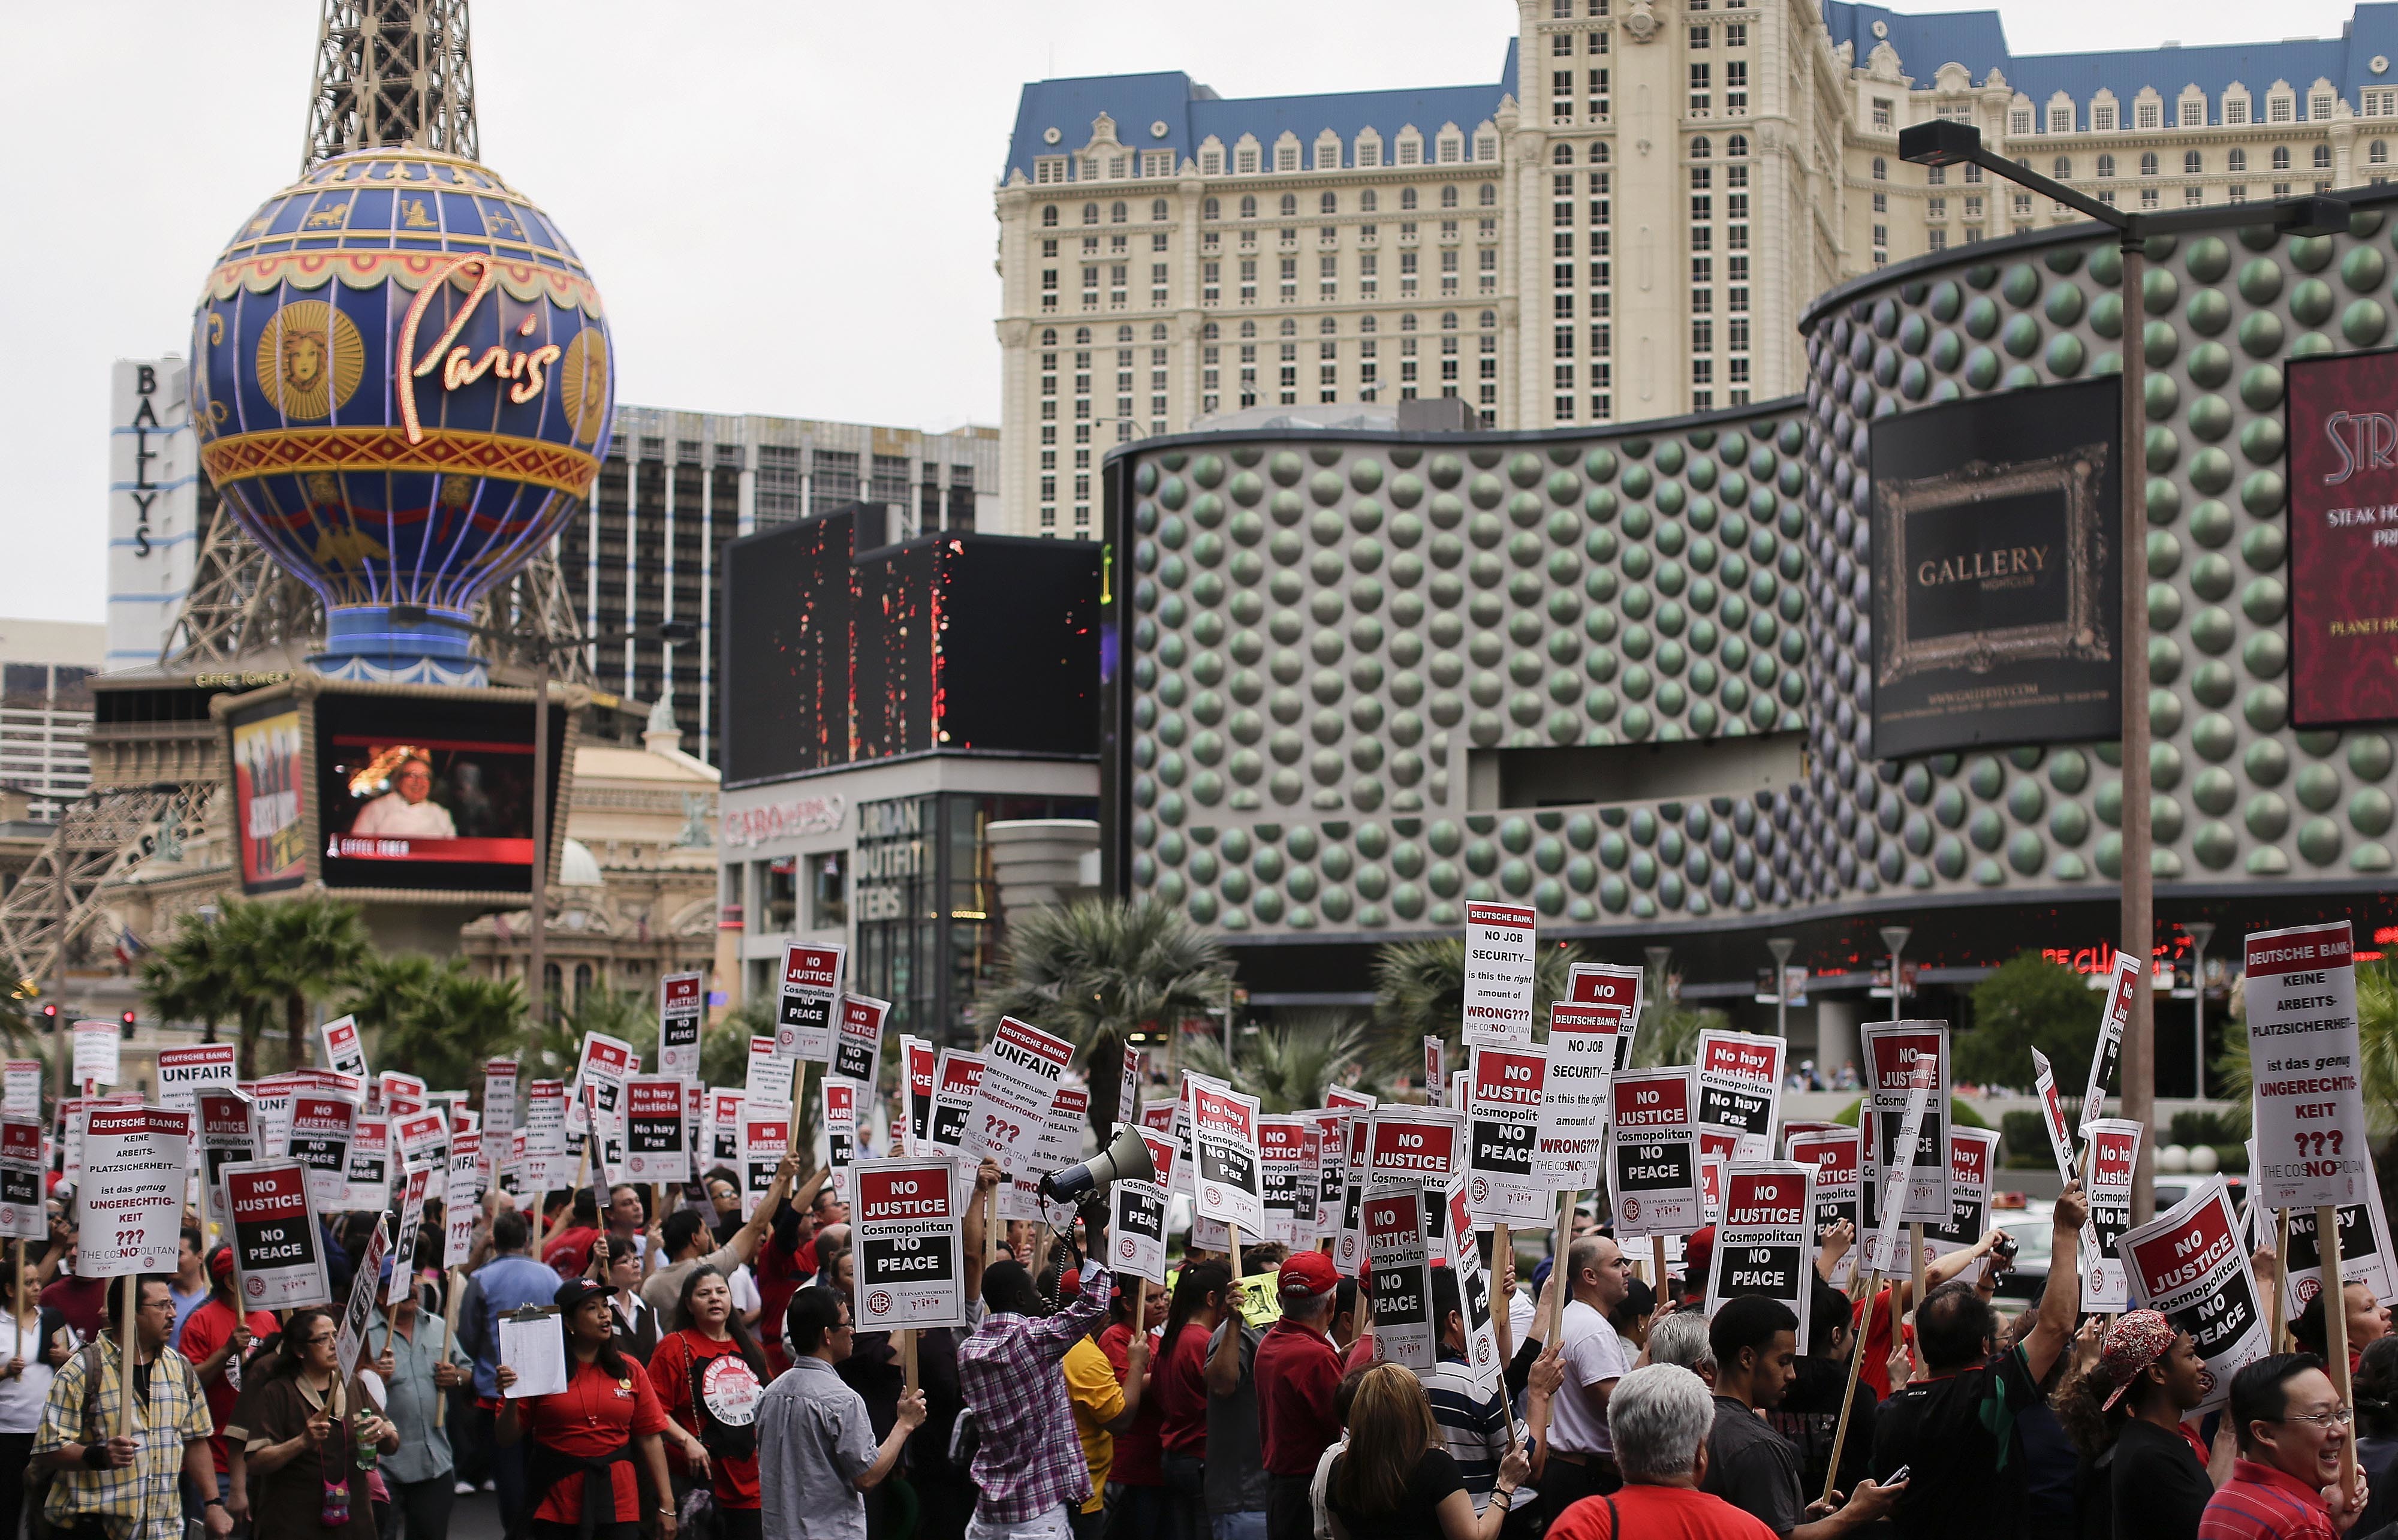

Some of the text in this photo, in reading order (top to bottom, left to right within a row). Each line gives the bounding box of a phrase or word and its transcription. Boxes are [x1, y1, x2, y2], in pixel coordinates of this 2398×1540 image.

[395, 251, 562, 444] Paris
[131, 364, 159, 557] BALLYS
[1918, 546, 2049, 586] GALLERY
[1471, 911, 1533, 924] DEUTSCHE BANK:
[1485, 931, 1523, 942] NO JOB
[807, 957, 820, 966] NO
[2249, 944, 2315, 966] DEUTSCHE
[2319, 942, 2350, 958] BANK:
[789, 969, 833, 982] JUSTICE
[1478, 972, 1494, 981] this
[1498, 973, 1511, 982] the
[1514, 974, 1532, 984] right
[2283, 972, 2325, 987] KEINE
[785, 985, 834, 998] Cosmopolitan
[1478, 990, 1521, 999] amount of
[1593, 985, 1615, 997] NO
[2123, 981, 2133, 1000] No
[2276, 994, 2337, 1012] ARBEITS-
[790, 1008, 823, 1020] PEACE
[852, 1010, 867, 1021] NO
[1467, 1006, 1529, 1021] WRONG???
[1555, 1015, 1617, 1026] DEUTSCHE BANK:
[671, 1029, 694, 1040] PEACE
[1465, 1023, 1478, 1031] THE
[1001, 1026, 1067, 1060] DEUTSCHE BANK:
[1568, 1039, 1603, 1052] NO JOB
[846, 1047, 861, 1057] NO
[1715, 1048, 1767, 1066] No hay
[1899, 1048, 1917, 1063] NO
[994, 1041, 1061, 1081] UNFAIR
[2267, 1057, 2309, 1072] ist das
[163, 1066, 231, 1081] UNFAIR
[1505, 1065, 1532, 1081] NO
[1700, 1072, 1773, 1095] Cosmopolitan
[2260, 1075, 2357, 1098] UNGERECHTIG-
[634, 1089, 675, 1099] No hay
[991, 1081, 1037, 1107] ist das genug
[1062, 1096, 1084, 1107] BANK:
[1546, 1093, 1607, 1106] is this the right
[1637, 1091, 1659, 1104] NO
[631, 1102, 678, 1113] Justicia
[979, 1089, 1043, 1122] UNGERECHTIGKEIT
[1710, 1092, 1762, 1113] No hay
[313, 1105, 332, 1116] NO
[1201, 1099, 1245, 1125] No hay
[1618, 1108, 1684, 1125] JUSTICE
[2295, 1102, 2336, 1119] KEIT
[92, 1117, 183, 1128] DEUTSCHE BANK:
[1556, 1116, 1596, 1127] amount of
[1720, 1111, 1748, 1126] Paz
[635, 1124, 675, 1134] No hay
[986, 1114, 1020, 1143] ???
[1049, 1122, 1079, 1133] HEALTH-
[1200, 1117, 1248, 1141] Justicia
[1498, 1125, 1526, 1141] NO
[124, 1134, 149, 1143] KEINE
[645, 1138, 665, 1147] Paz
[1198, 1129, 1255, 1157] Cosmopolitan
[1266, 1132, 1286, 1142] NO
[1398, 1134, 1423, 1147] NO
[1616, 1129, 1693, 1144] Cosmopolitan
[2294, 1129, 2344, 1158] ???
[1540, 1138, 1599, 1154] WRONG???
[1640, 1146, 1662, 1159] NO
[2099, 1145, 2116, 1162] No
[1060, 1156, 1079, 1165] right
[1205, 1145, 1249, 1171] No hay
[1375, 1153, 1447, 1170] JUSTICE
[1819, 1152, 1836, 1165] NO
[1954, 1147, 1978, 1166] hay
[1219, 1163, 1243, 1182] Paz
[1535, 1161, 1553, 1170] THE
[1629, 1164, 1679, 1180] PEACE
[2263, 1164, 2282, 1179] THE
[252, 1181, 276, 1193] NO
[1266, 1175, 1285, 1185] NO
[136, 1184, 166, 1192] genug
[891, 1181, 918, 1195] NO
[1755, 1186, 1777, 1200] NO
[90, 1197, 175, 1209] UNGERECHTIG-
[235, 1194, 303, 1211] JUSTICE
[865, 1199, 945, 1216] JUSTICE
[119, 1213, 143, 1222] KEIT
[1730, 1209, 1800, 1223] JUSTICE
[1821, 1204, 1838, 1217] NO
[2097, 1208, 2115, 1224] No
[1374, 1211, 1396, 1226] NO
[862, 1221, 953, 1236] Cosmopolitan
[2289, 1219, 2315, 1236] No
[116, 1229, 144, 1245] ???
[260, 1229, 284, 1242] NO
[1722, 1231, 1802, 1244] Cosmopolitan
[249, 1243, 302, 1259] PEACE
[893, 1238, 920, 1251] NO
[2175, 1229, 2202, 1258] NO
[82, 1250, 101, 1259] THE
[1749, 1249, 1770, 1264] NO
[878, 1256, 938, 1272] PEACE
[2153, 1232, 2232, 1293] JUSTICE
[2351, 1264, 2381, 1277] WORKERS
[1381, 1274, 1402, 1290] NO
[1732, 1271, 1785, 1286] PEACE
[2149, 1255, 2242, 1312] Cosmopolitan
[2198, 1292, 2225, 1321] NO
[2220, 1332, 2263, 1372] CULINARY WORKERS
